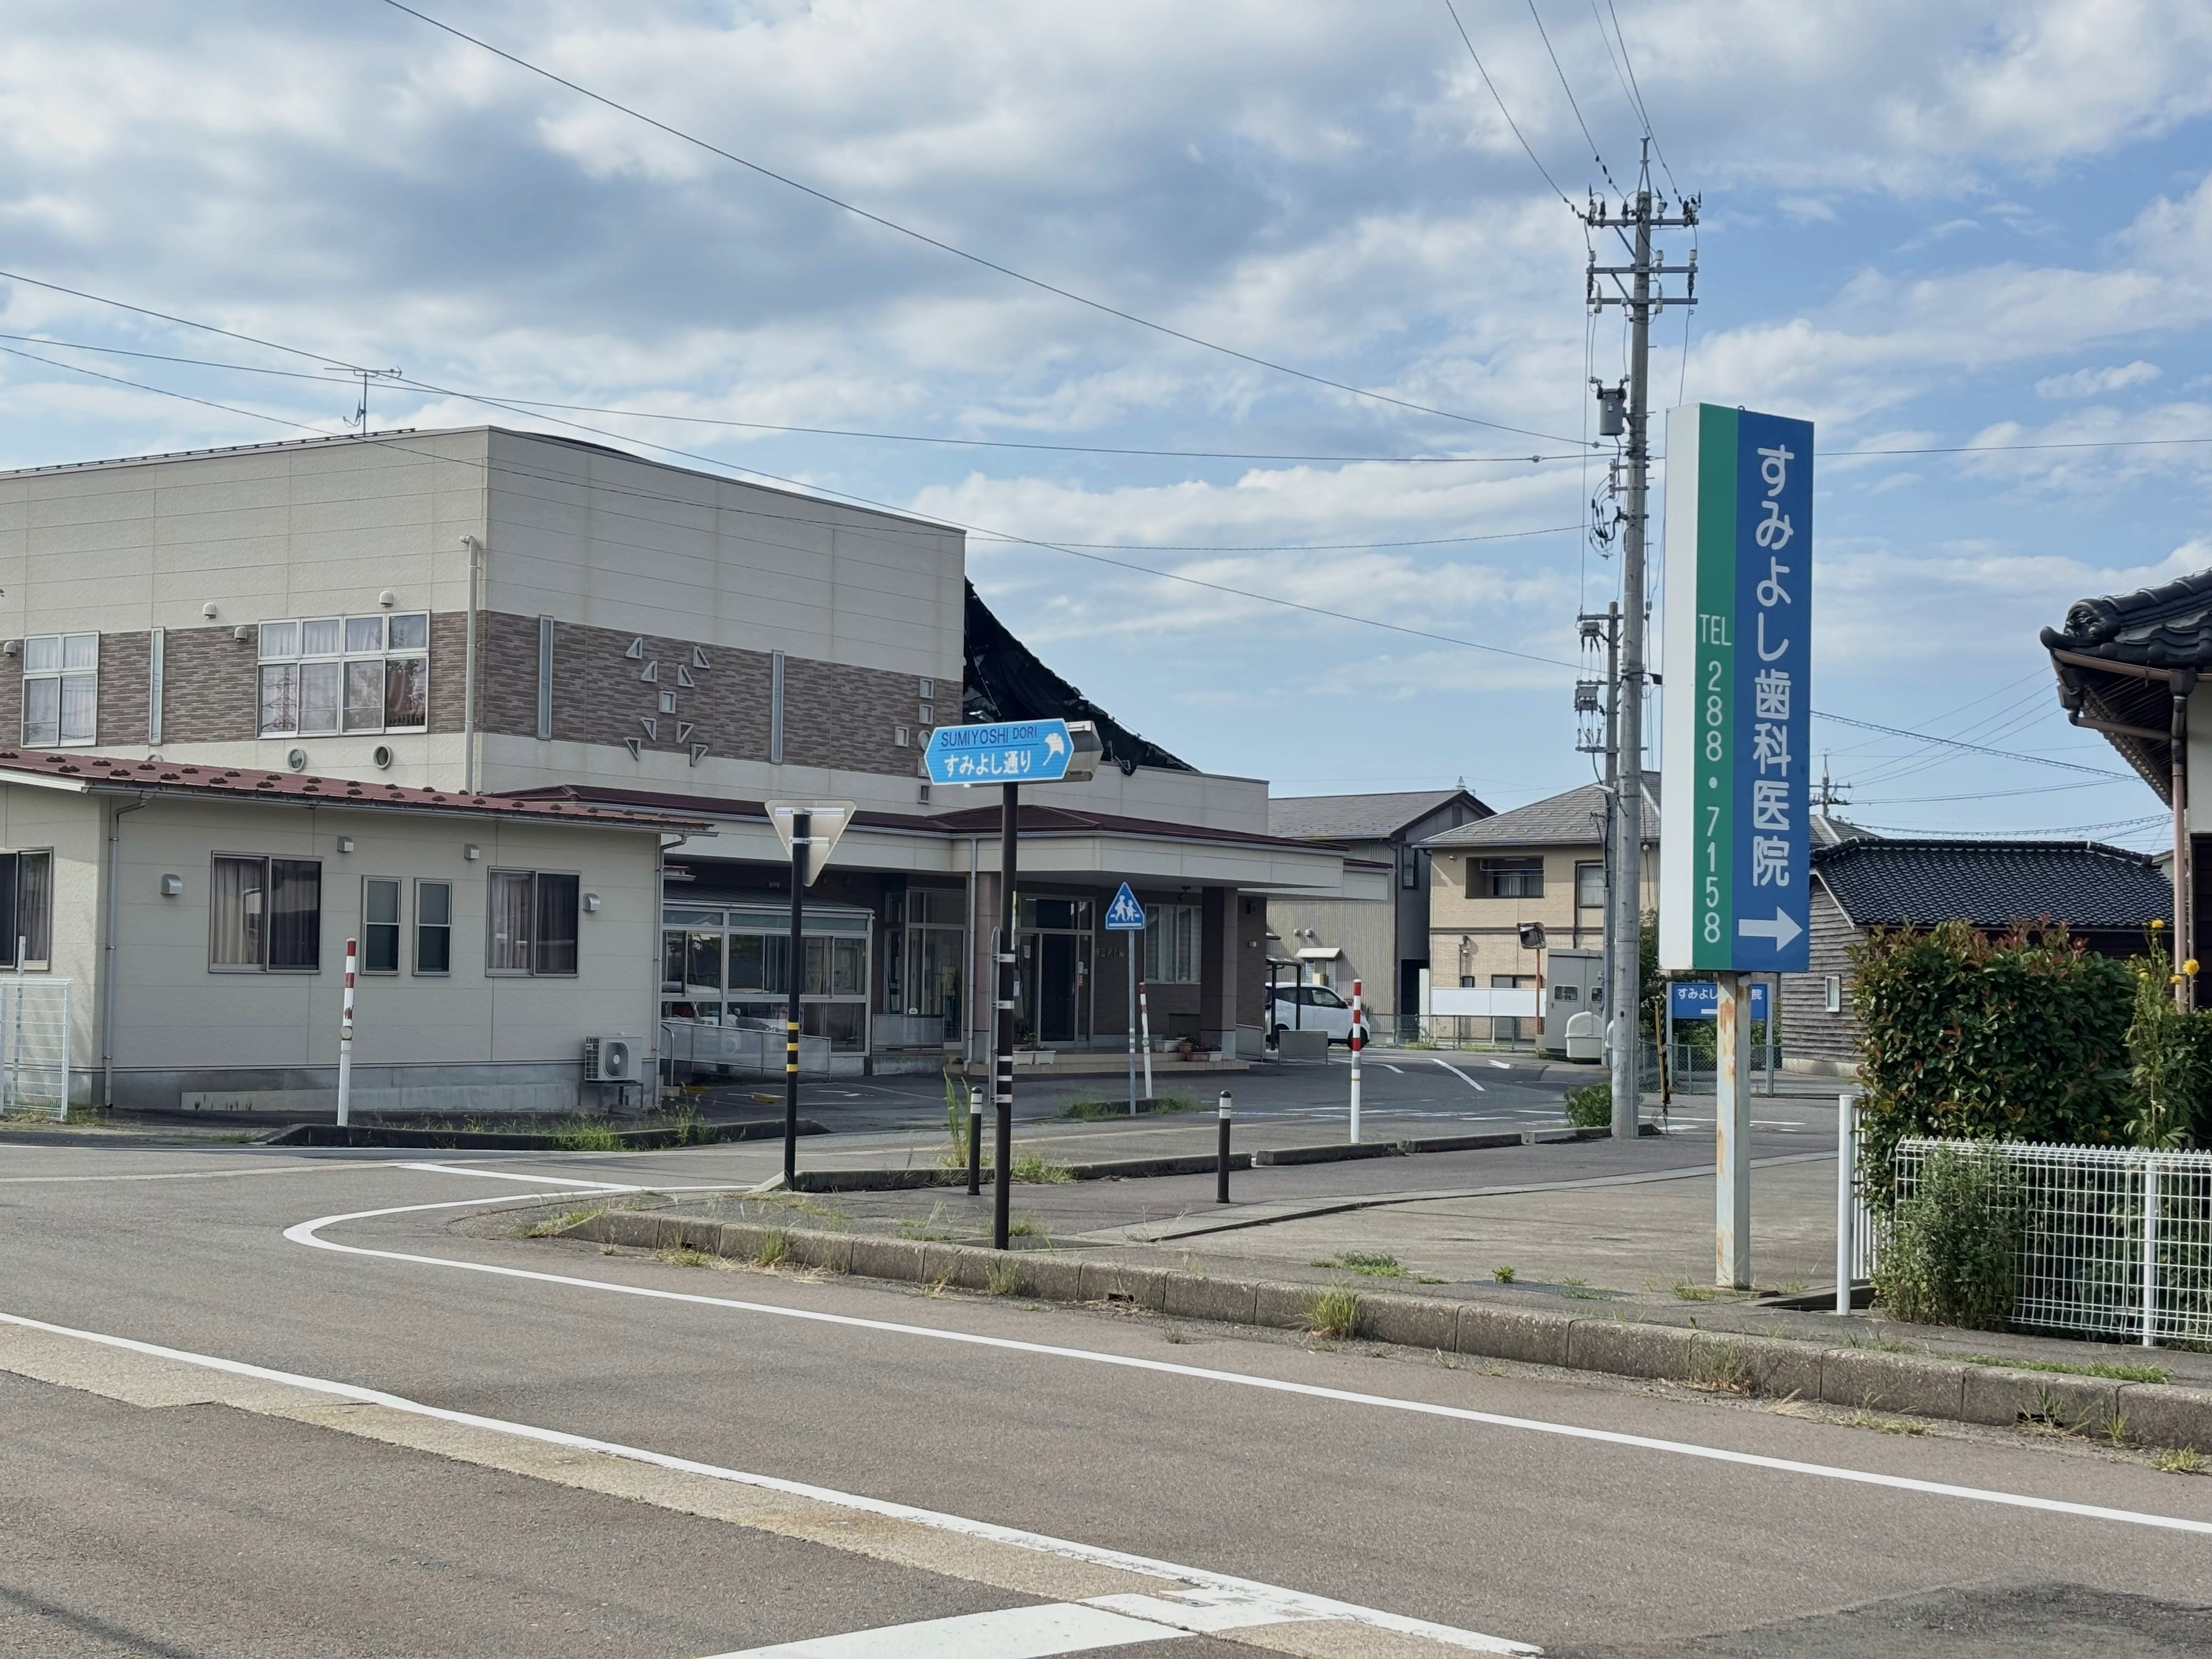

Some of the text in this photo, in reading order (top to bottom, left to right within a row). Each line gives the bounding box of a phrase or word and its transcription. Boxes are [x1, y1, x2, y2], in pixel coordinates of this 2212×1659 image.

[1699, 613, 1732, 646] TEL
[1753, 444, 1795, 887] すみよし歯科医院
[941, 726, 1037, 747] SUMIYOSHI DORI
[944, 750, 1031, 777] すみよし通り
[1677, 988, 1763, 1000] すみよし院
